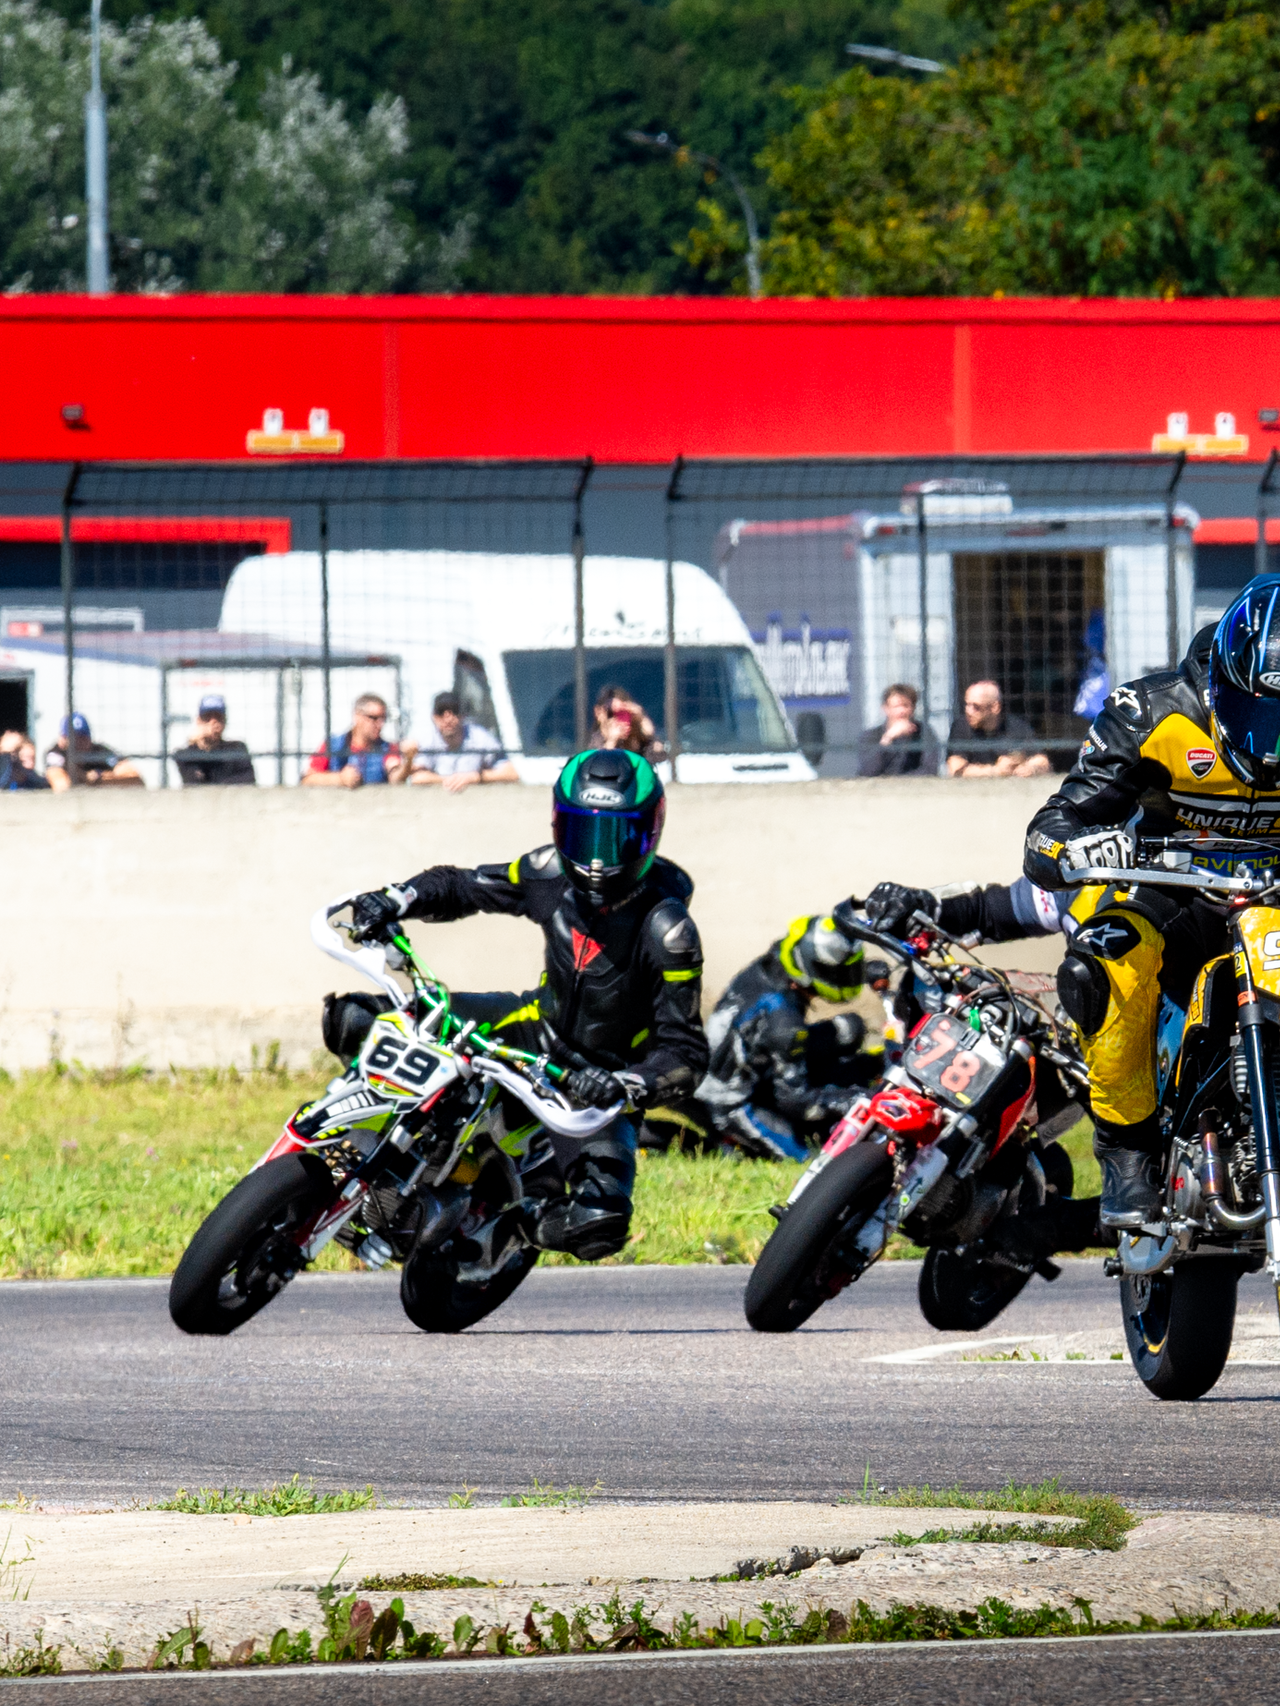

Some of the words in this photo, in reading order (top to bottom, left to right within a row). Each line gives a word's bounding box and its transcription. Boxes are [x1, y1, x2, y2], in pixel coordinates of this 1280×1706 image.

[1189, 752, 1214, 760] DUCATI
[365, 1034, 441, 1086] 69
[913, 1024, 981, 1093] 78
